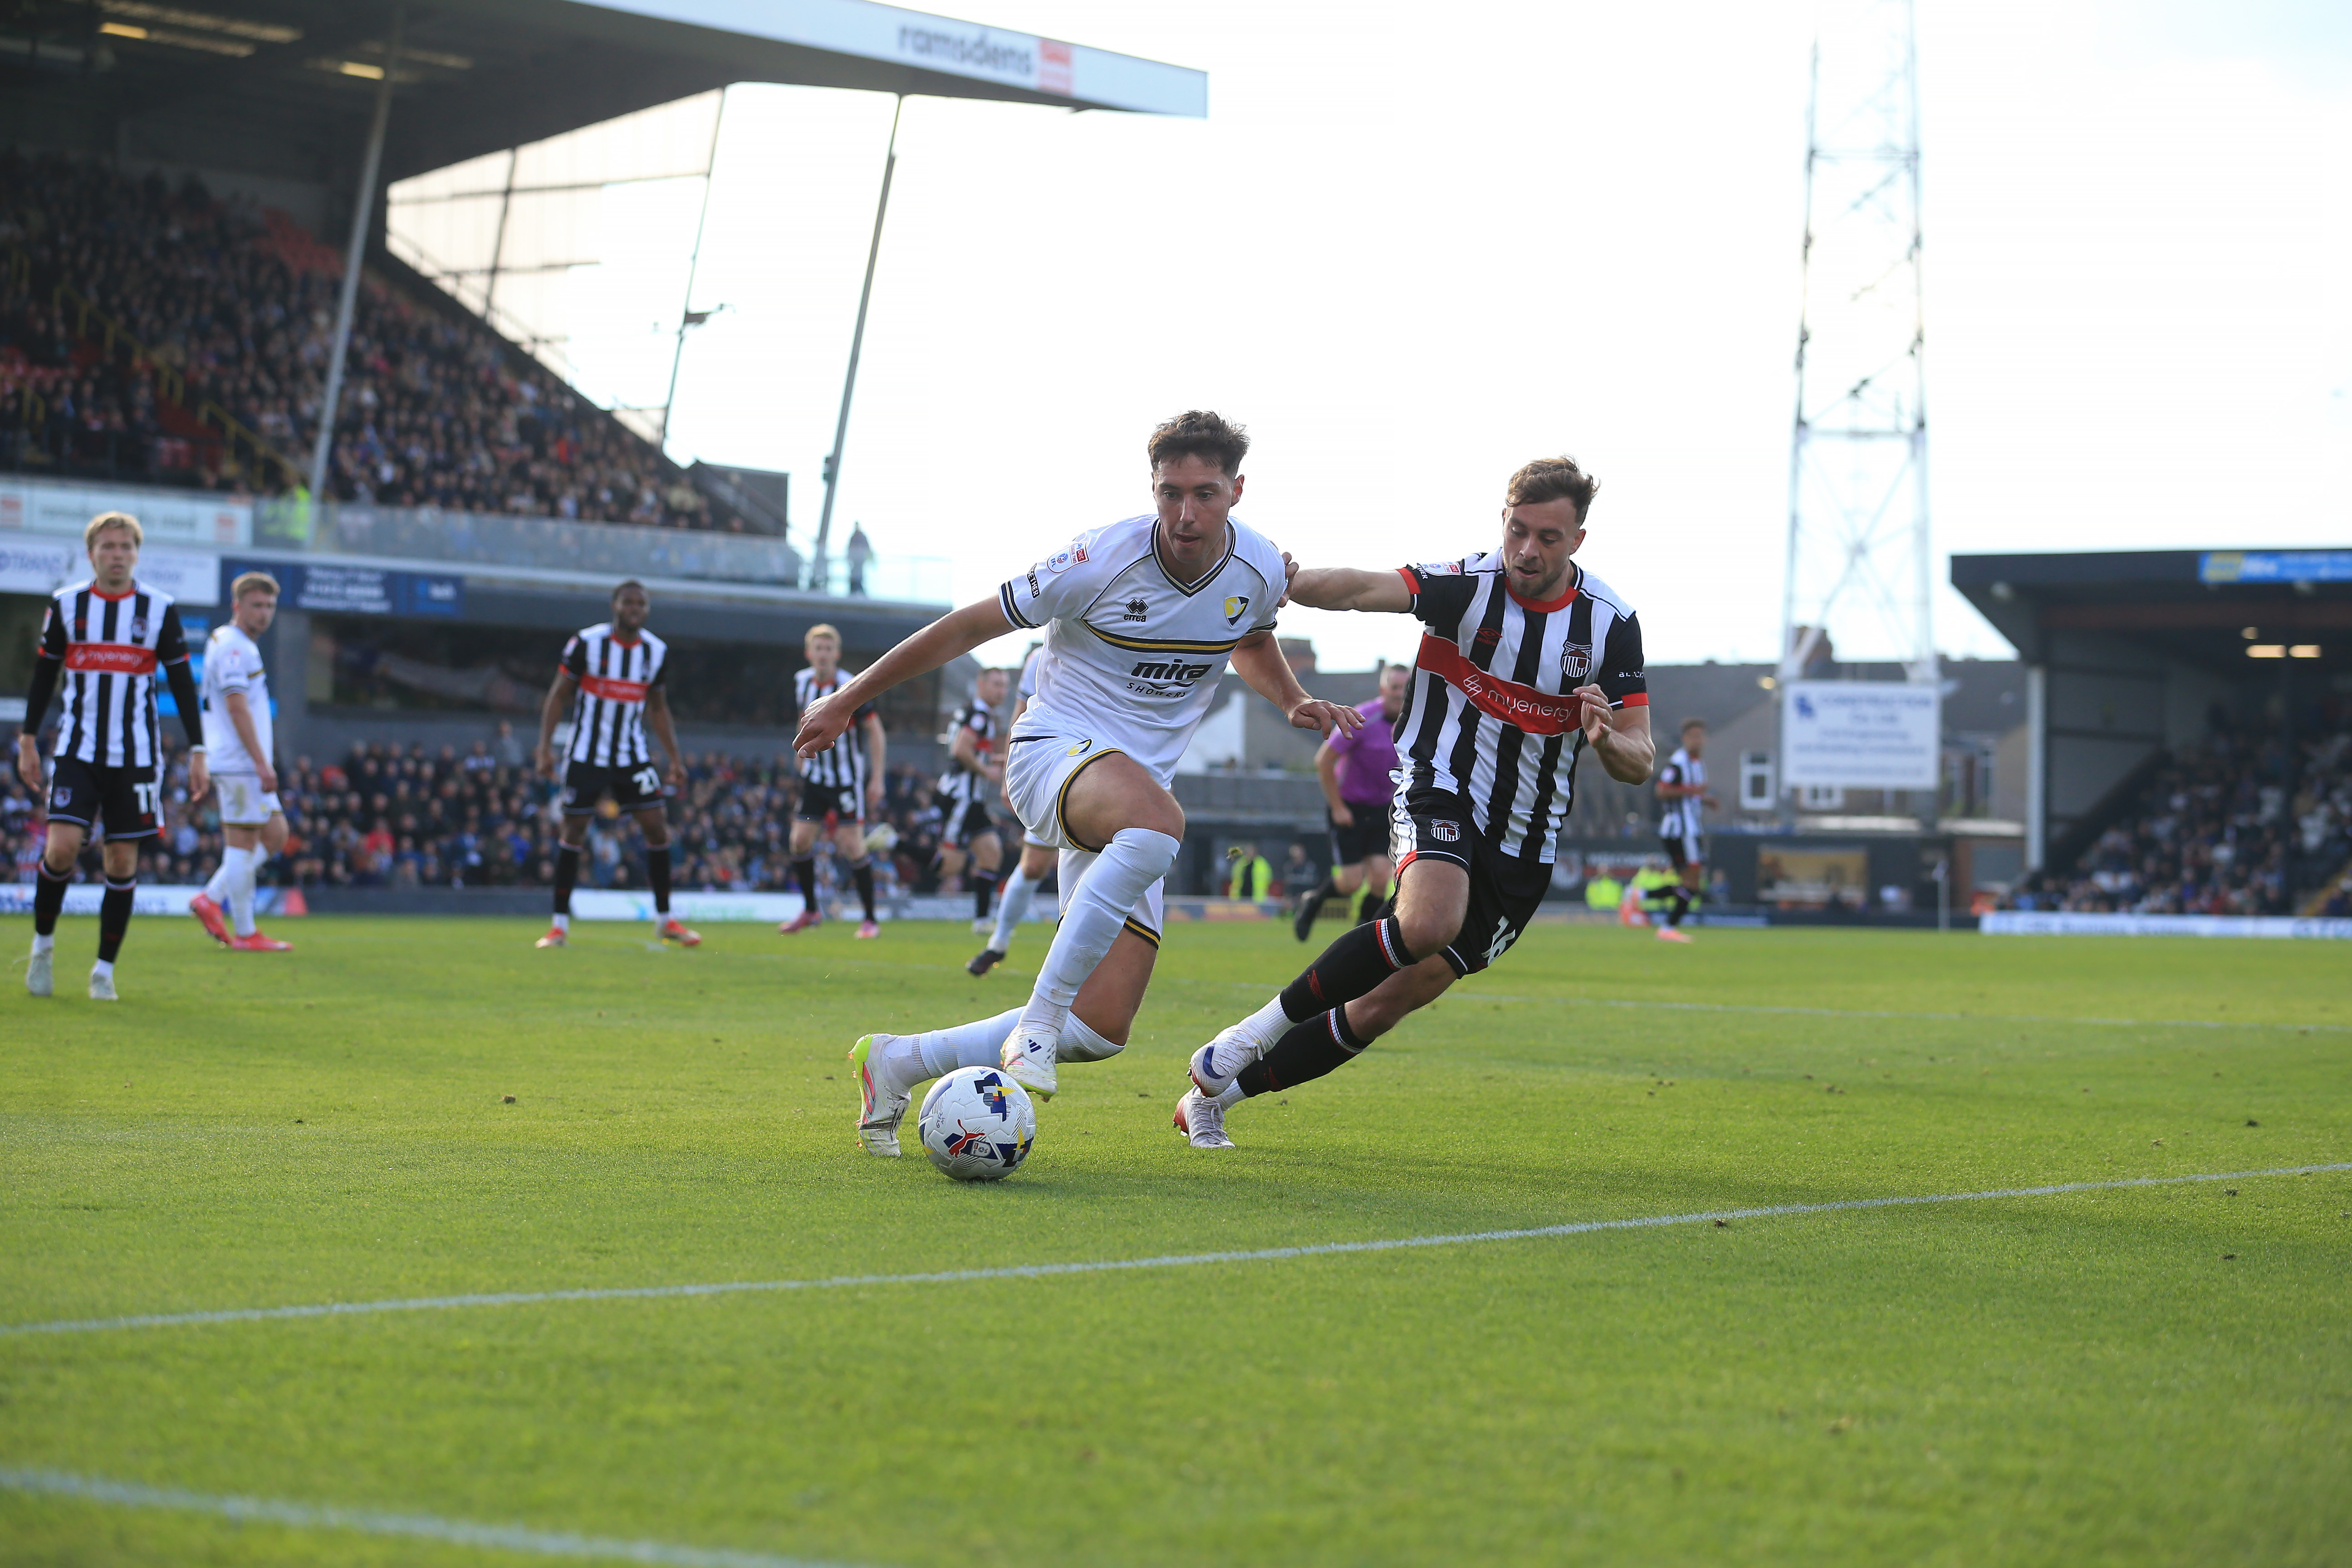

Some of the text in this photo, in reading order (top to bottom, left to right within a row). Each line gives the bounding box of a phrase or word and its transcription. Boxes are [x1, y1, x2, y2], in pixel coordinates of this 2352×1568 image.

[898, 26, 1032, 76] ramsdens
[1123, 614, 1147, 622] errea
[1131, 659, 1212, 681] mira
[1488, 690, 1575, 722] myenergi
[132, 782, 158, 814] 11
[1481, 916, 1515, 965] 16
